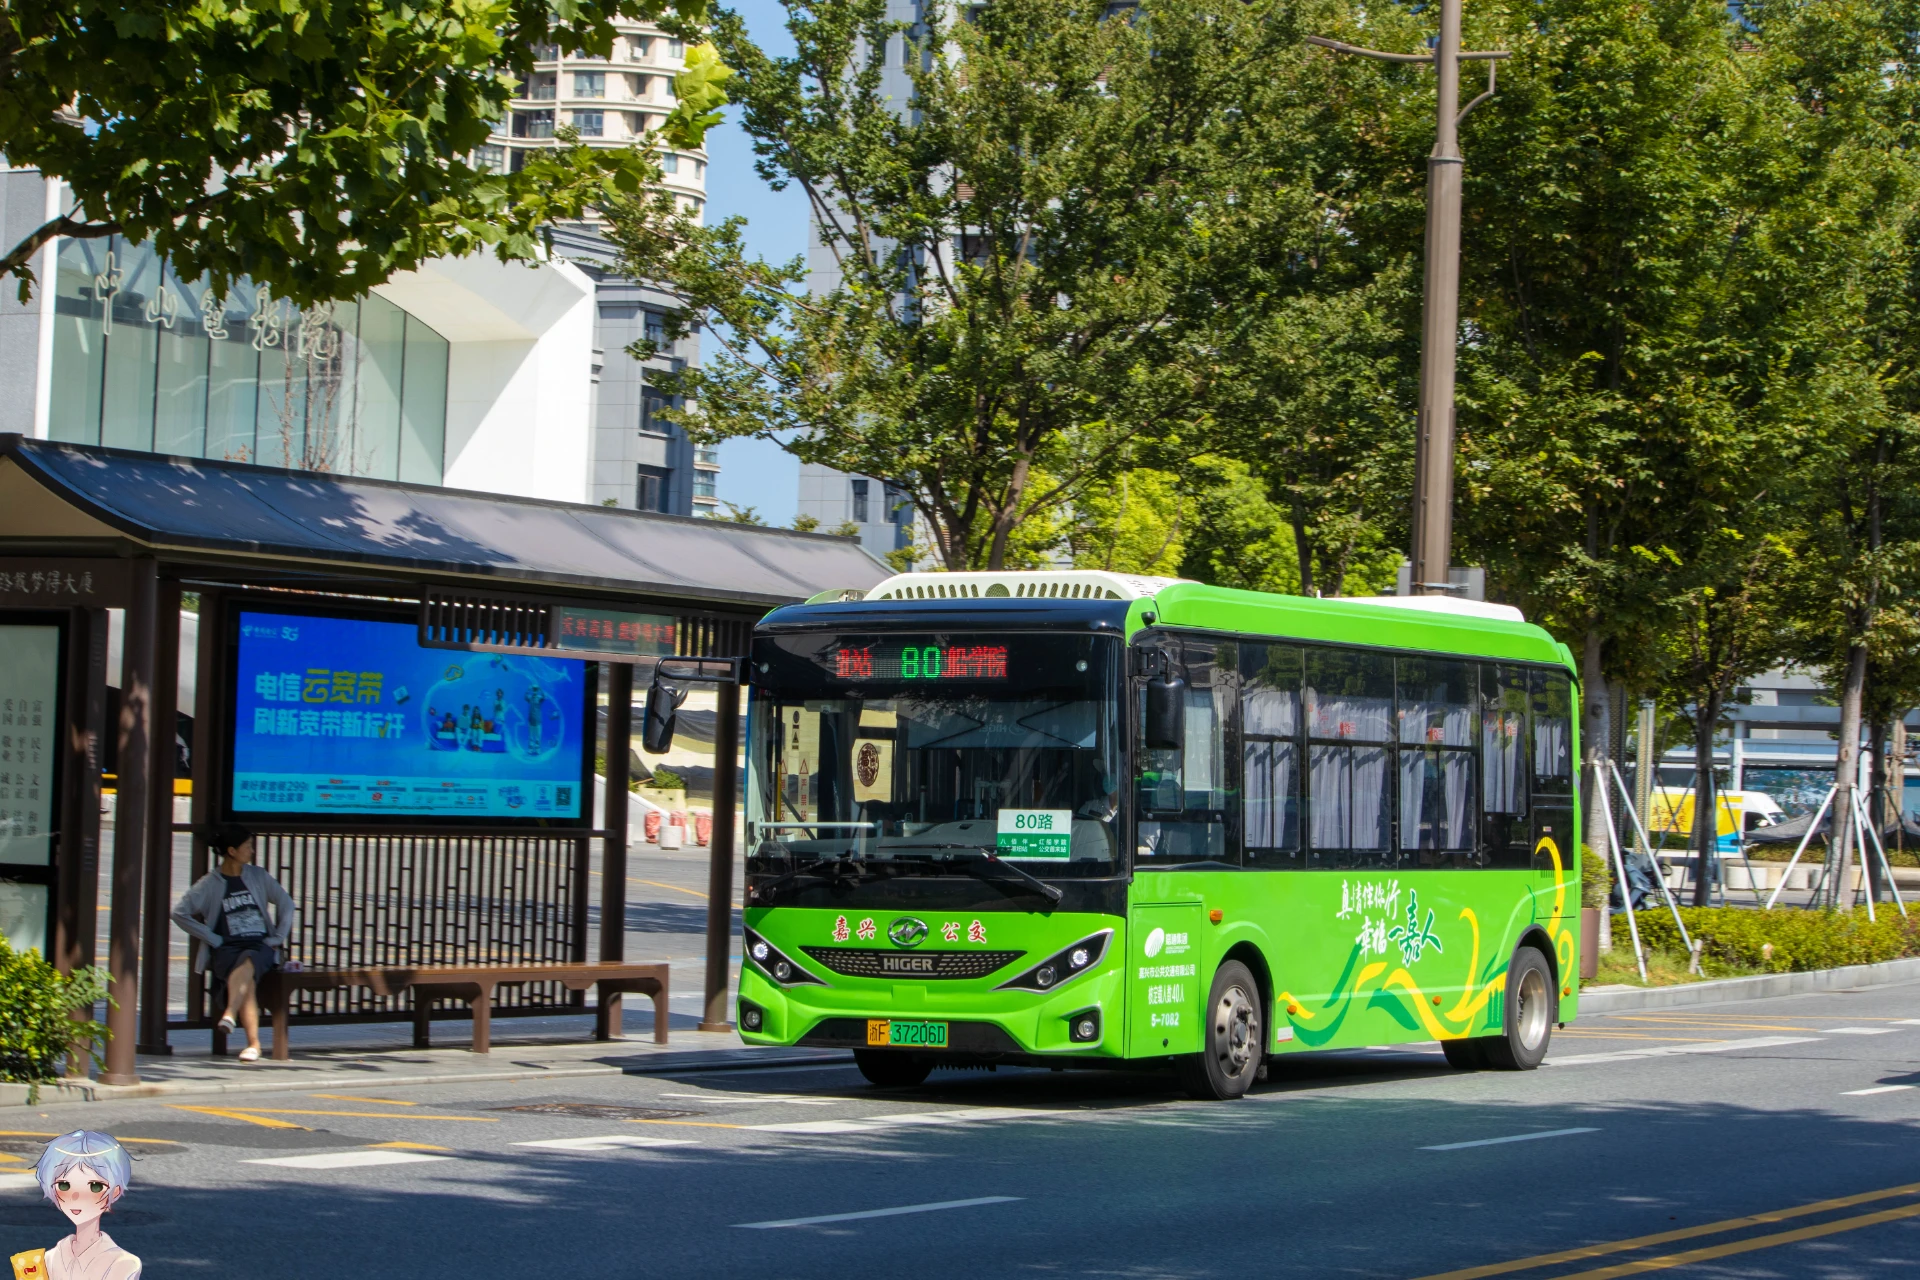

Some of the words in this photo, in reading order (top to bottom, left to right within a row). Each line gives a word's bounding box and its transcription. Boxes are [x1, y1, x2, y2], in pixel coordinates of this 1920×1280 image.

[902, 646, 940, 678] 80
[255, 668, 383, 705] 电信云宽带
[253, 707, 405, 739] 刷新宽带新标杆
[1015, 814, 1053, 830] 80路
[832, 915, 877, 942] 嘉兴
[941, 920, 987, 943] 公交
[883, 958, 933, 971] HIGER
[1138, 964, 1196, 979] 嘉兴市公共交通有限公司
[1151, 1012, 1180, 1028] 5-7082
